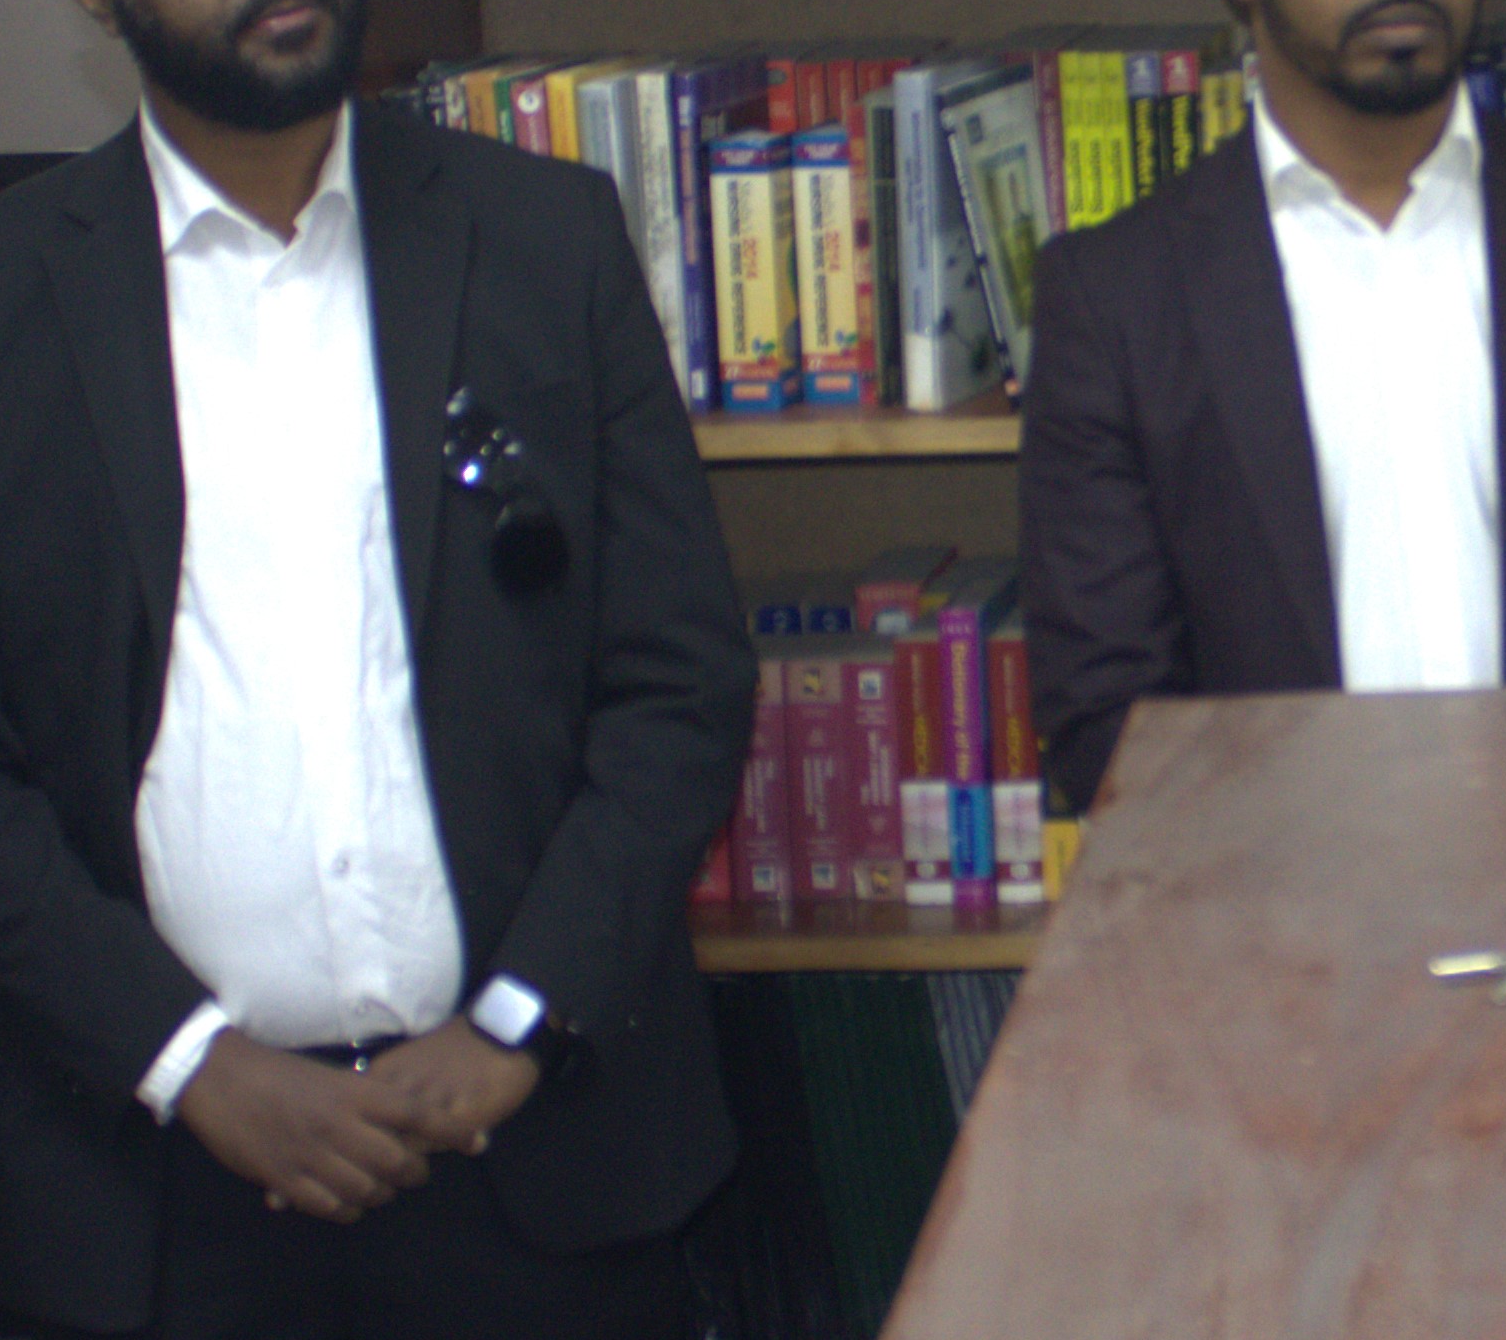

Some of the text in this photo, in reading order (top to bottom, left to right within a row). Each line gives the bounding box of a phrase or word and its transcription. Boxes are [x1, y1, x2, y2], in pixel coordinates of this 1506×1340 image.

[727, 180, 749, 355] NURSING DRUG REFERENCE
[742, 238, 760, 280] 2014
[809, 174, 832, 348] NURSING DRUG REFERENCE
[824, 231, 842, 273] 2014
[949, 640, 970, 727] Dictionary
[953, 730, 972, 751] of
